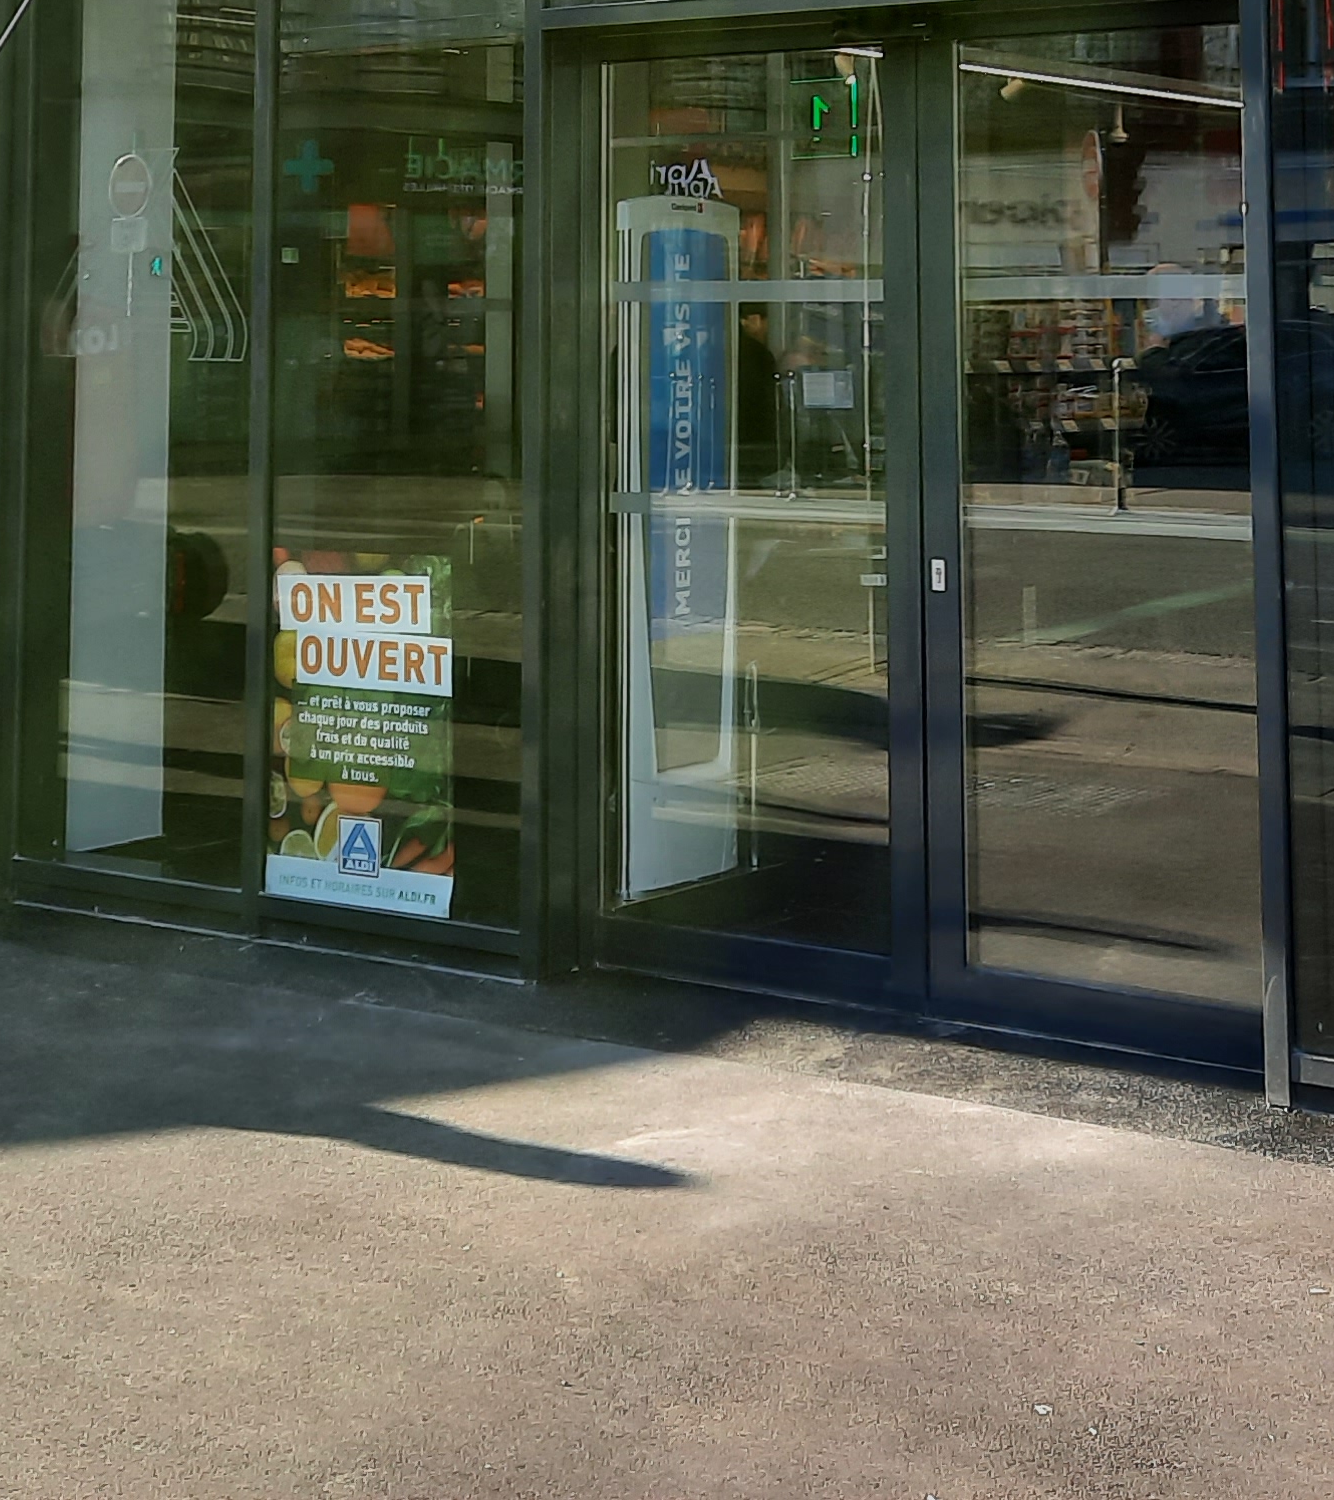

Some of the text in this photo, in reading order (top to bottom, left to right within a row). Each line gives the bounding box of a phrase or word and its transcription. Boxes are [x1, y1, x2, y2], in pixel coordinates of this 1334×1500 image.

[674, 516, 693, 617] MERCI
[290, 582, 425, 625] ON EST
[300, 635, 449, 686] OUVERT
[353, 702, 378, 712] vous
[381, 703, 431, 717] proposer
[298, 710, 429, 735] chaque jour des produits
[316, 728, 339, 743] frais
[341, 732, 352, 744] et
[369, 735, 410, 750] qualité
[318, 748, 332, 759] un
[333, 749, 354, 763] prix
[357, 753, 415, 769] accessible
[351, 768, 379, 783] tous.
[345, 860, 374, 872] ALDI
[279, 874, 436, 905] INFOS ET HORAIRES SUR ALDI.FR
